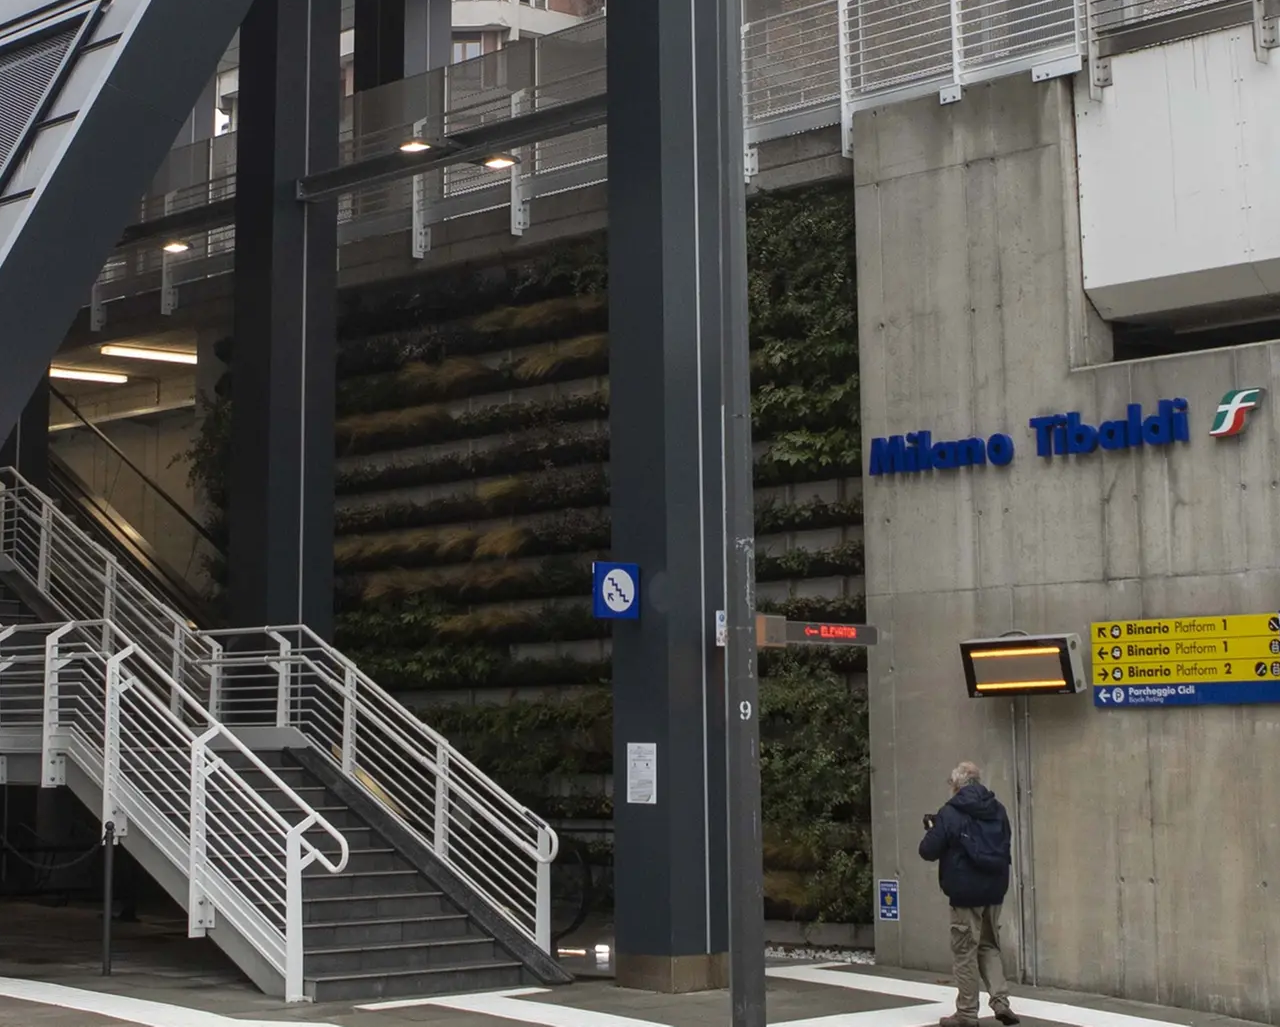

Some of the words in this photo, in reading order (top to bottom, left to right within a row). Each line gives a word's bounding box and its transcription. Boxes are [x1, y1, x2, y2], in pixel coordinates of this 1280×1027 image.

[870, 430, 1015, 476] Milano
[1029, 397, 1190, 458] Tibaldi
[820, 625, 857, 639] ELEVATOR
[1126, 622, 1169, 635] Binario
[1174, 619, 1216, 633] Platform
[1222, 619, 1227, 631] 1
[1127, 643, 1170, 656] Binario
[1175, 640, 1217, 654] Platform
[1223, 641, 1228, 652] 1
[1128, 664, 1171, 678] Binario
[1176, 662, 1218, 676] Platform
[1224, 663, 1232, 674] 2
[1128, 686, 1176, 697] Parcheggio
[1177, 685, 1195, 694] Cicli
[1128, 696, 1145, 704] Bicycle
[1145, 695, 1164, 704] Parking
[739, 700, 752, 721] 9
